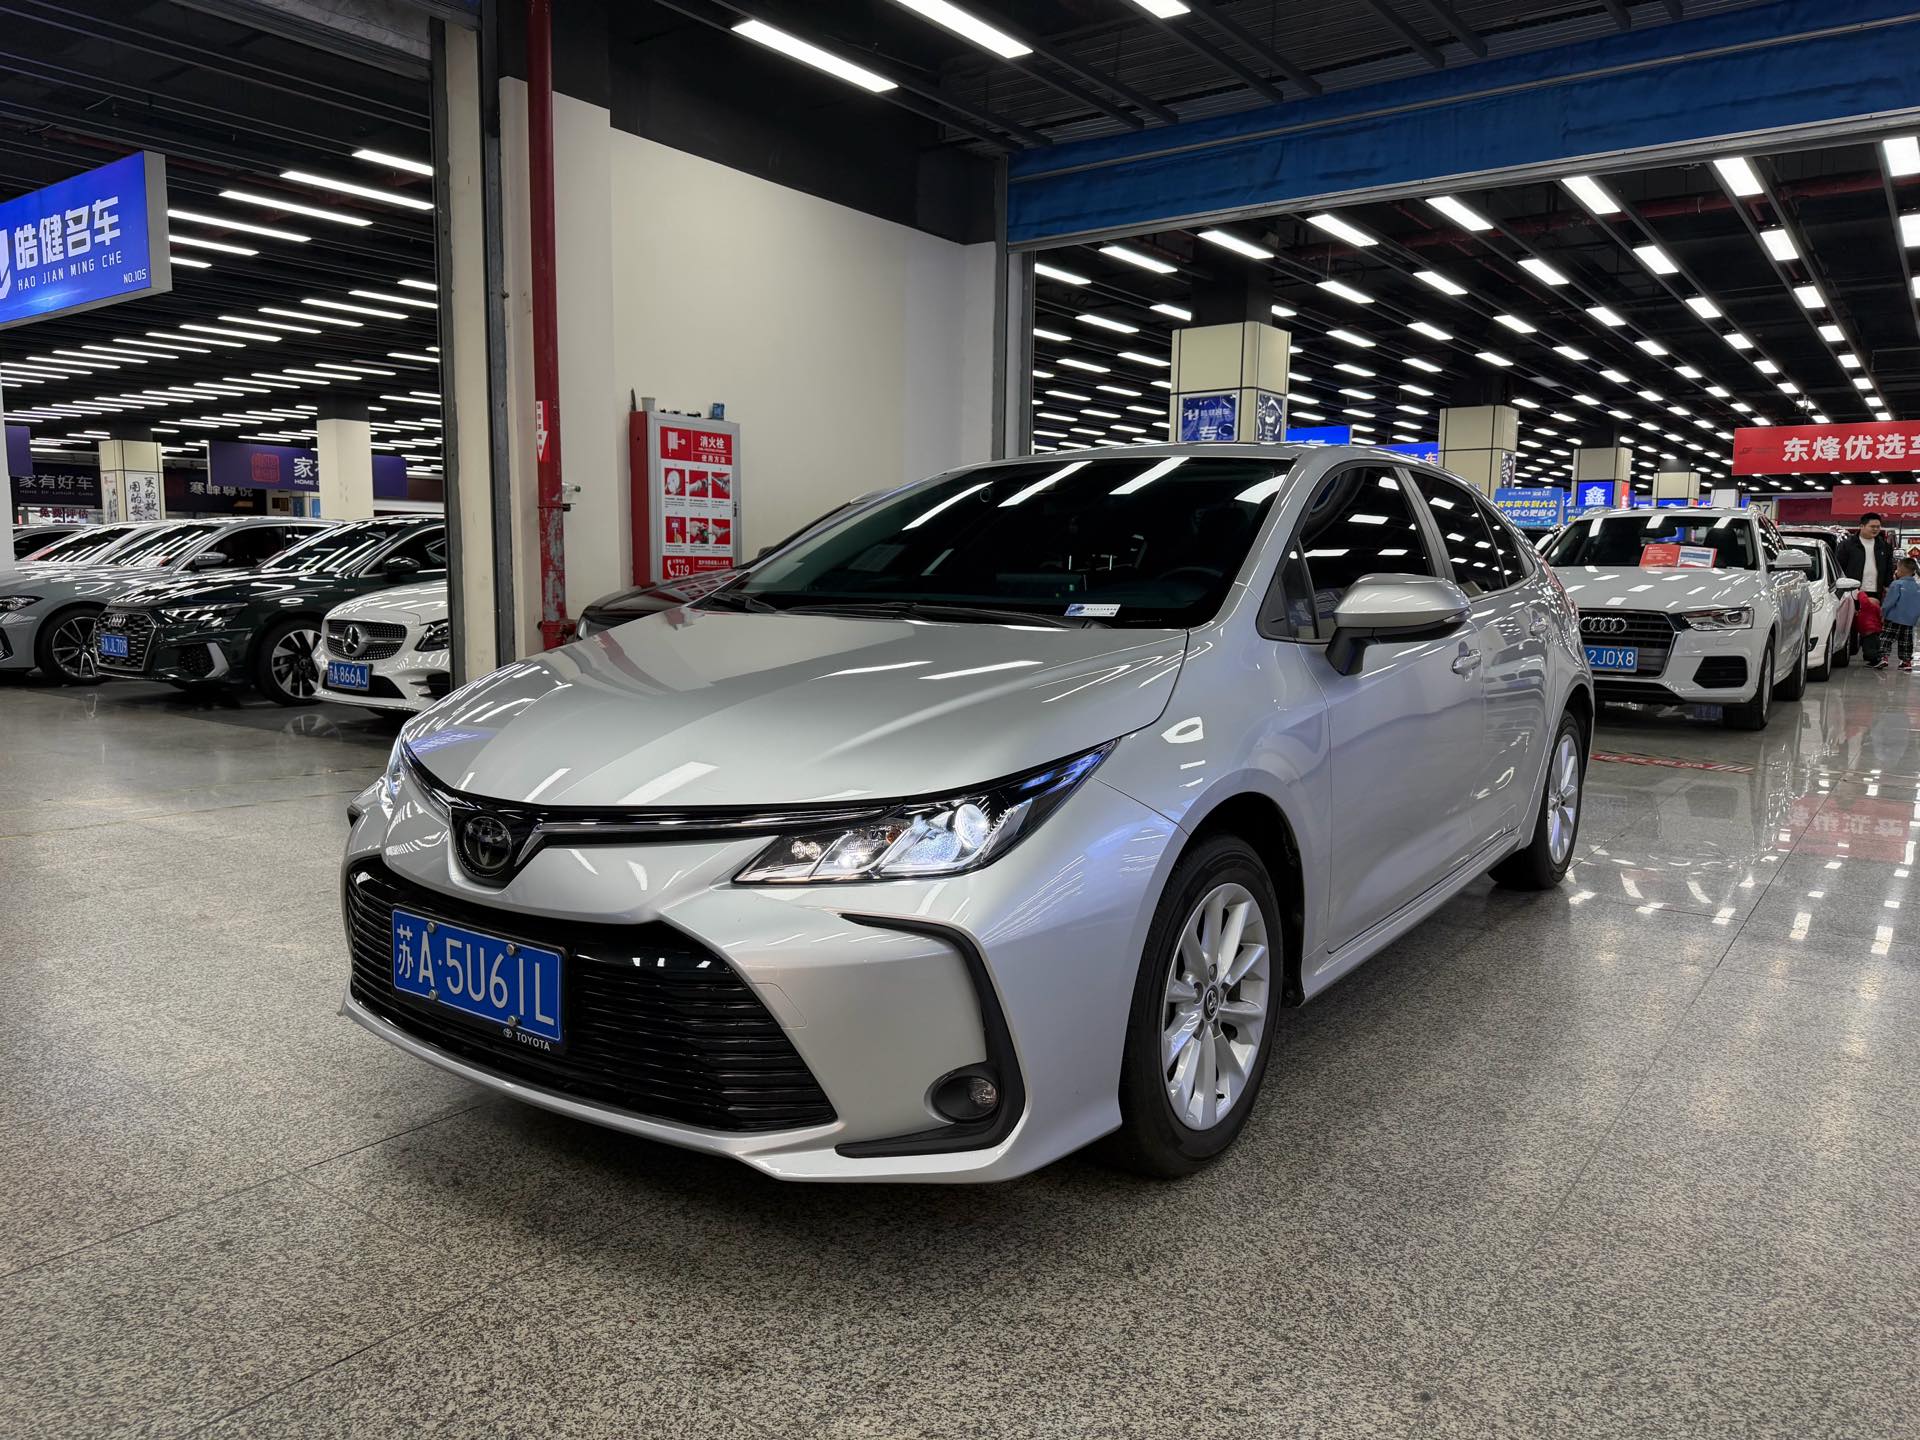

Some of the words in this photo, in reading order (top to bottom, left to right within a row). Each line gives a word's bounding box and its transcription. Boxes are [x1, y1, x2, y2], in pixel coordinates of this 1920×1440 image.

[15, 196, 121, 271] 皓健名车
[18, 276, 36, 291] HAO
[42, 269, 64, 285] JIAN
[70, 258, 95, 276] MING
[102, 251, 122, 268] CHE
[123, 268, 147, 284] NO.105
[700, 435, 725, 449] 消火栓
[294, 457, 318, 478] 家
[19, 474, 94, 490] 家有好车
[130, 481, 143, 521] 用的安
[675, 564, 690, 576] 119
[397, 924, 554, 1026] 苏A·5U61L
[516, 1031, 551, 1051] TOYOTA
